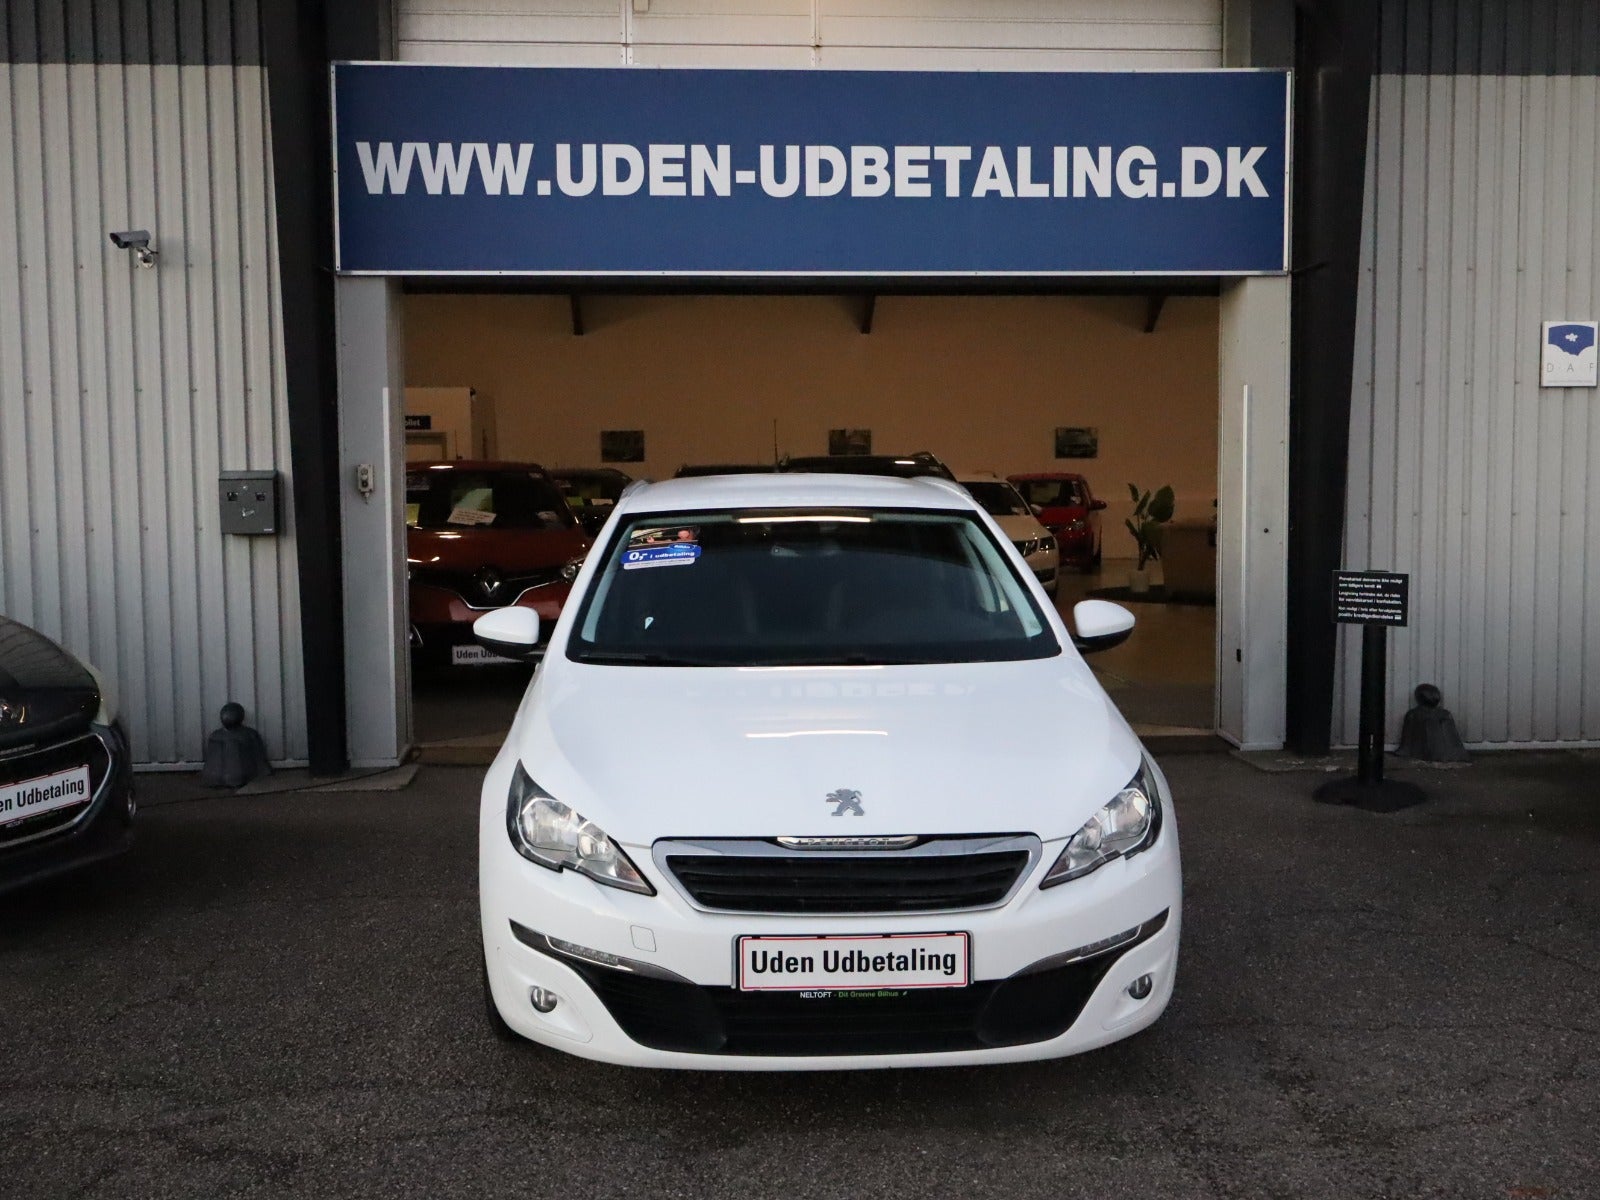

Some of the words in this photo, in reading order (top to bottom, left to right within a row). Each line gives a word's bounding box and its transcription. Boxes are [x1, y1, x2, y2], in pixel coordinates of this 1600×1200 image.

[356, 141, 1270, 198] WWW.UDEN-UDBETALING.DK
[456, 650, 479, 659] Uden
[16, 779, 84, 808] Udbetaling
[808, 838, 890, 846] PEUGEOT
[751, 950, 814, 973] Uden
[823, 948, 956, 976] Udbetaling
[800, 991, 832, 999] NELTOFT
